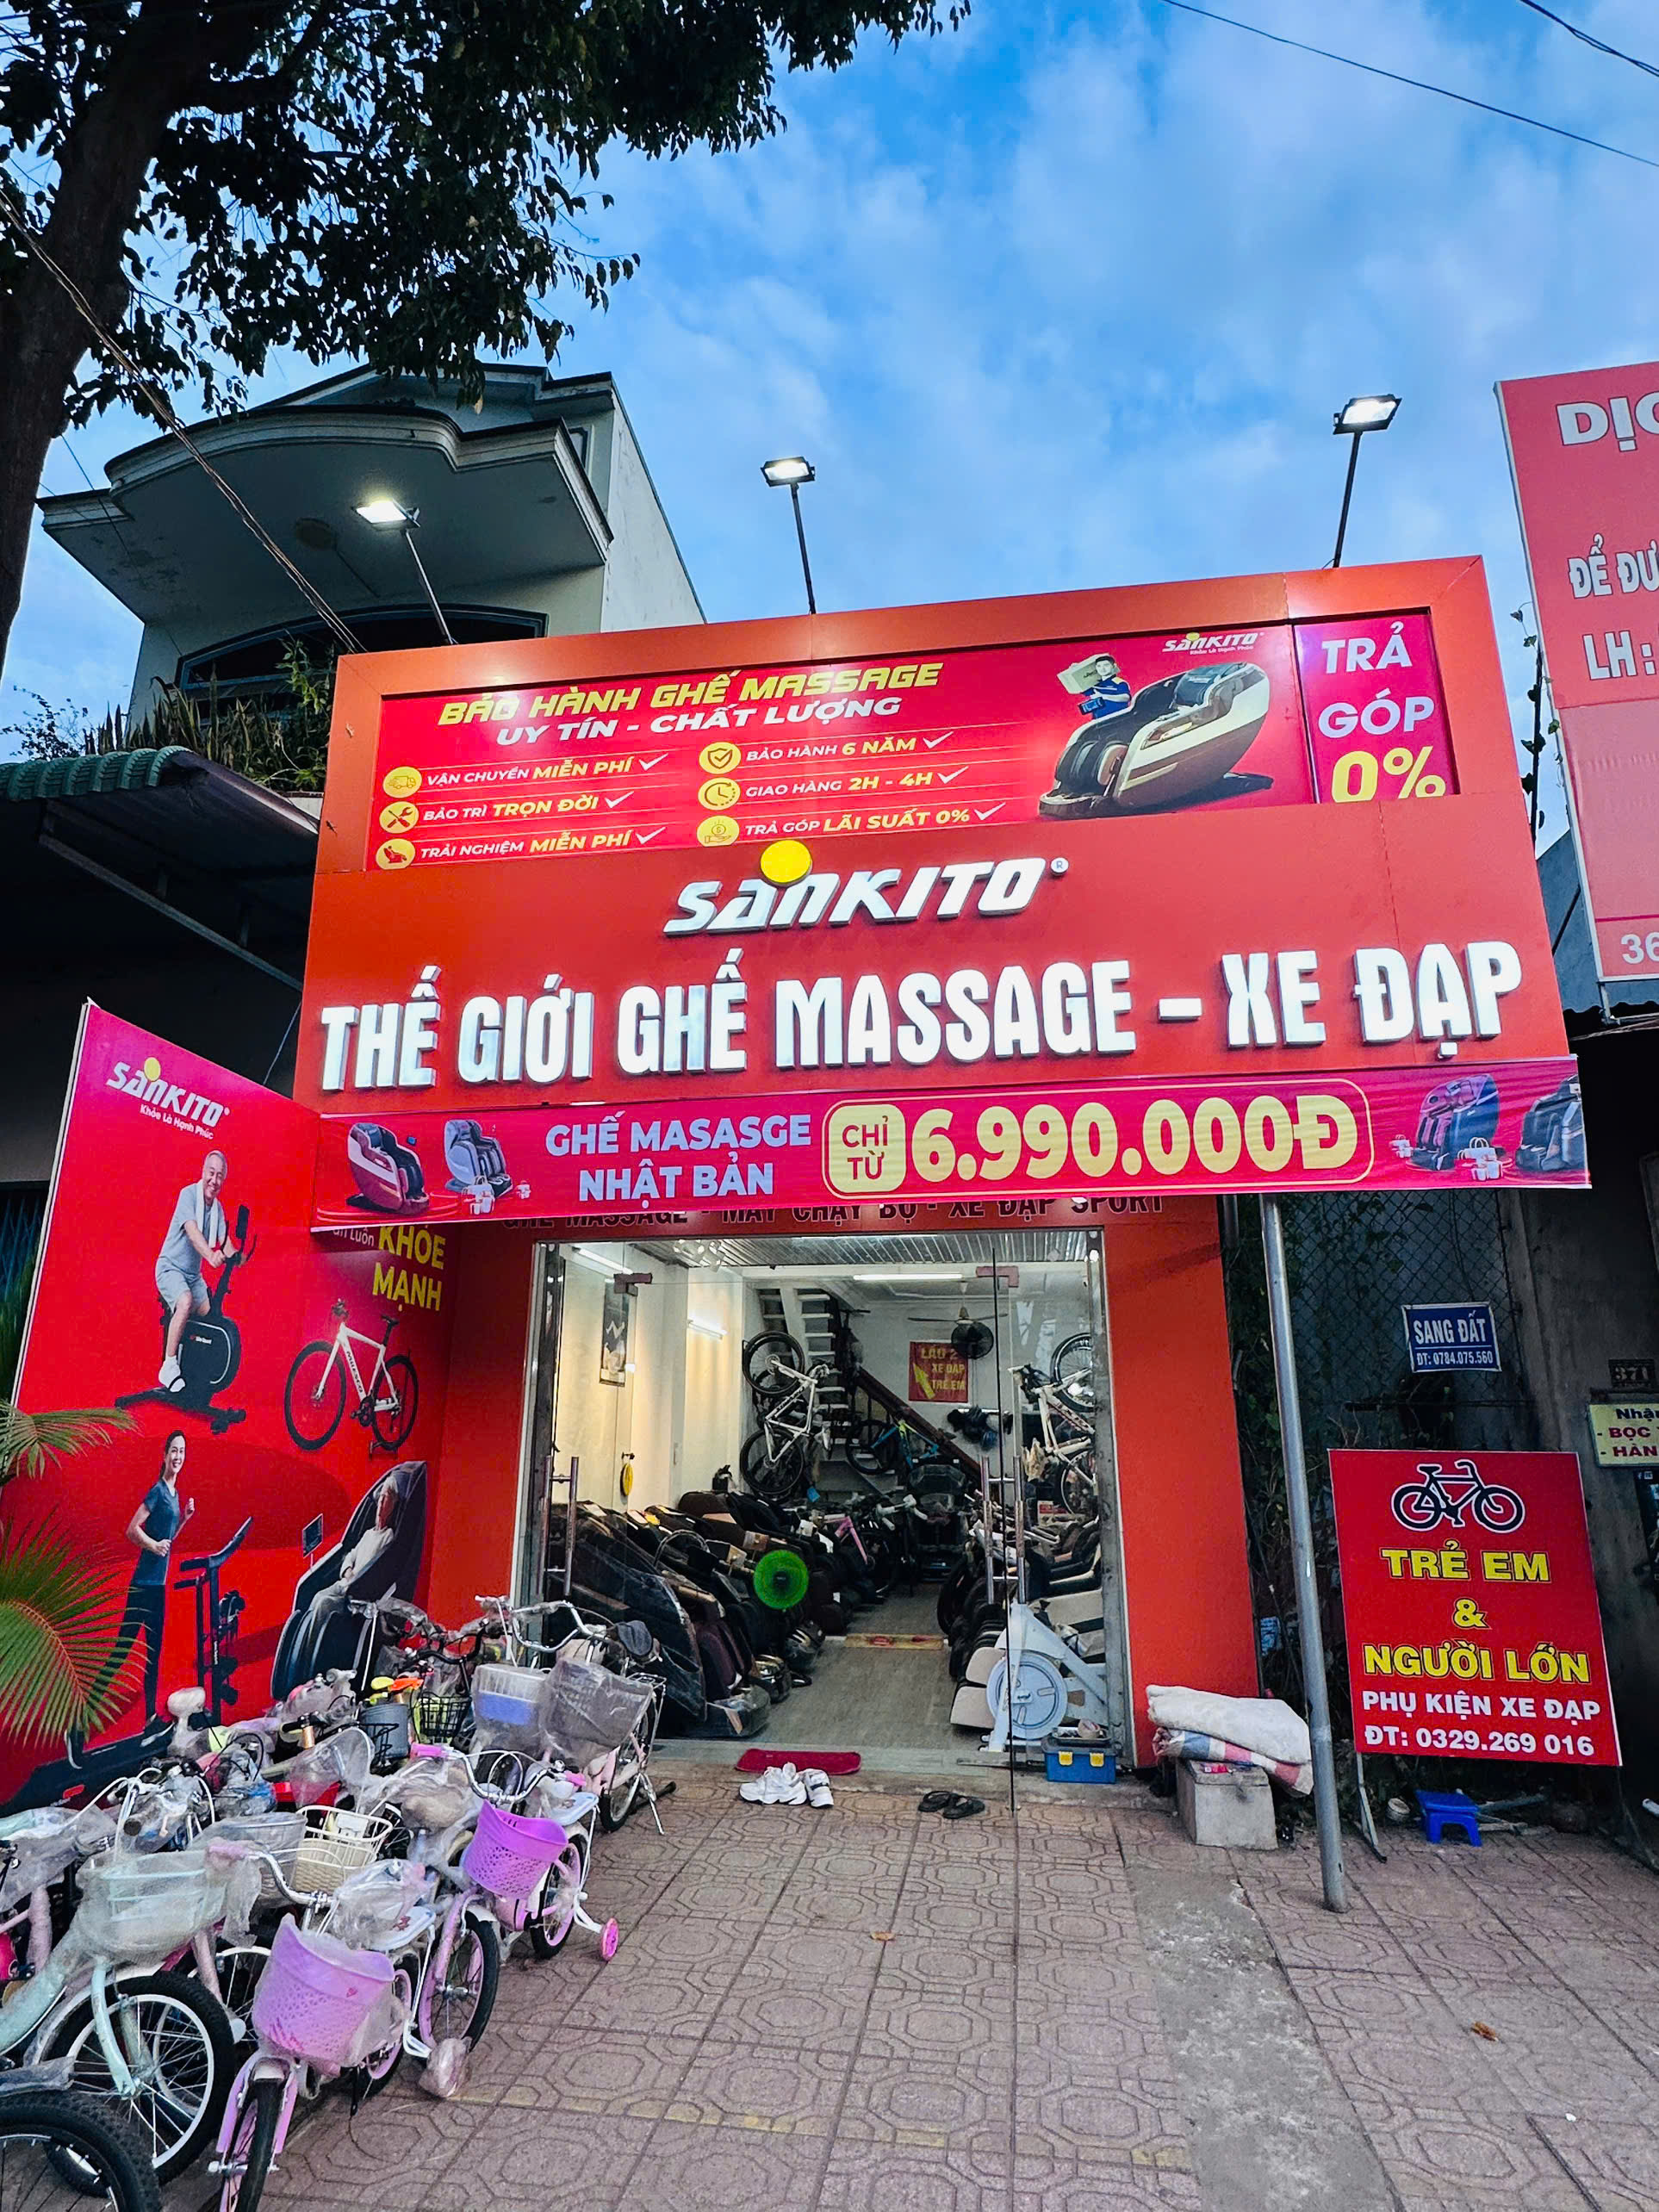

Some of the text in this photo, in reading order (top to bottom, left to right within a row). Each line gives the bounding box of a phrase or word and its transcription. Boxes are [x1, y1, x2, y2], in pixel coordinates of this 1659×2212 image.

[1568, 533, 1614, 600] ĐỂ
[1322, 622, 1413, 674] TRẢ
[438, 662, 944, 725] BẢO HÀNH GHẾ MASSAGE
[496, 725, 550, 746] UY
[558, 717, 618, 741] TÍN
[650, 704, 758, 733] CHẤT
[764, 697, 902, 724] LƯỢNG
[1318, 688, 1435, 740] GÓP
[746, 736, 916, 761] BẢO HÀNH 6 NĂM
[427, 772, 461, 787] VẬN
[532, 758, 588, 780] MIỄN
[594, 756, 634, 774] PHÍ
[745, 784, 787, 798] GIAO
[792, 780, 842, 794] HÀNG
[848, 776, 879, 791] 2H
[899, 772, 933, 786] 4H
[1331, 747, 1445, 803] 0%
[423, 795, 599, 820] BẢO TRÌ TRỌN ĐỜI
[745, 808, 970, 836] TRẢ GÓP LÃI SUẤT 0%
[420, 830, 632, 858] TRẢI NGHIỆM MIỄN PHÍ
[320, 965, 442, 1091] THẾ
[457, 972, 595, 1085] GIỚI
[618, 948, 748, 1076] GHẾ
[775, 960, 1136, 1069] MASSAGE
[1221, 950, 1327, 1047] XE
[1354, 941, 1522, 1060] ĐẠP
[140, 1104, 161, 1121] Khỏe
[163, 1113, 172, 1124] Là
[842, 1115, 889, 1148] CHỈ
[546, 1110, 811, 1156] GHẾ MASASGE
[911, 1095, 1358, 1183] 6.990.000Đ
[579, 1151, 774, 1209] NHẬT BẢN
[847, 1150, 885, 1180] TỪ
[948, 1202, 985, 1218] XE
[997, 1198, 1056, 1221] ĐẠP
[1071, 1195, 1164, 1215] SPORT
[372, 1262, 443, 1312] MẠNH
[1413, 1310, 1487, 1345] SANG ĐẤT
[1416, 1352, 1432, 1366] ĐT:
[1608, 1426, 1651, 1441] BỌC
[1381, 1539, 1550, 1583] TRẺ EM
[1453, 1598, 1491, 1630] &
[1363, 1638, 1591, 1683] NGƯỜI LỚN
[1362, 1690, 1600, 1725] PHỤ KIỆN XE ĐẠP
[1364, 1724, 1594, 1755] ĐT: 0329.269 016
